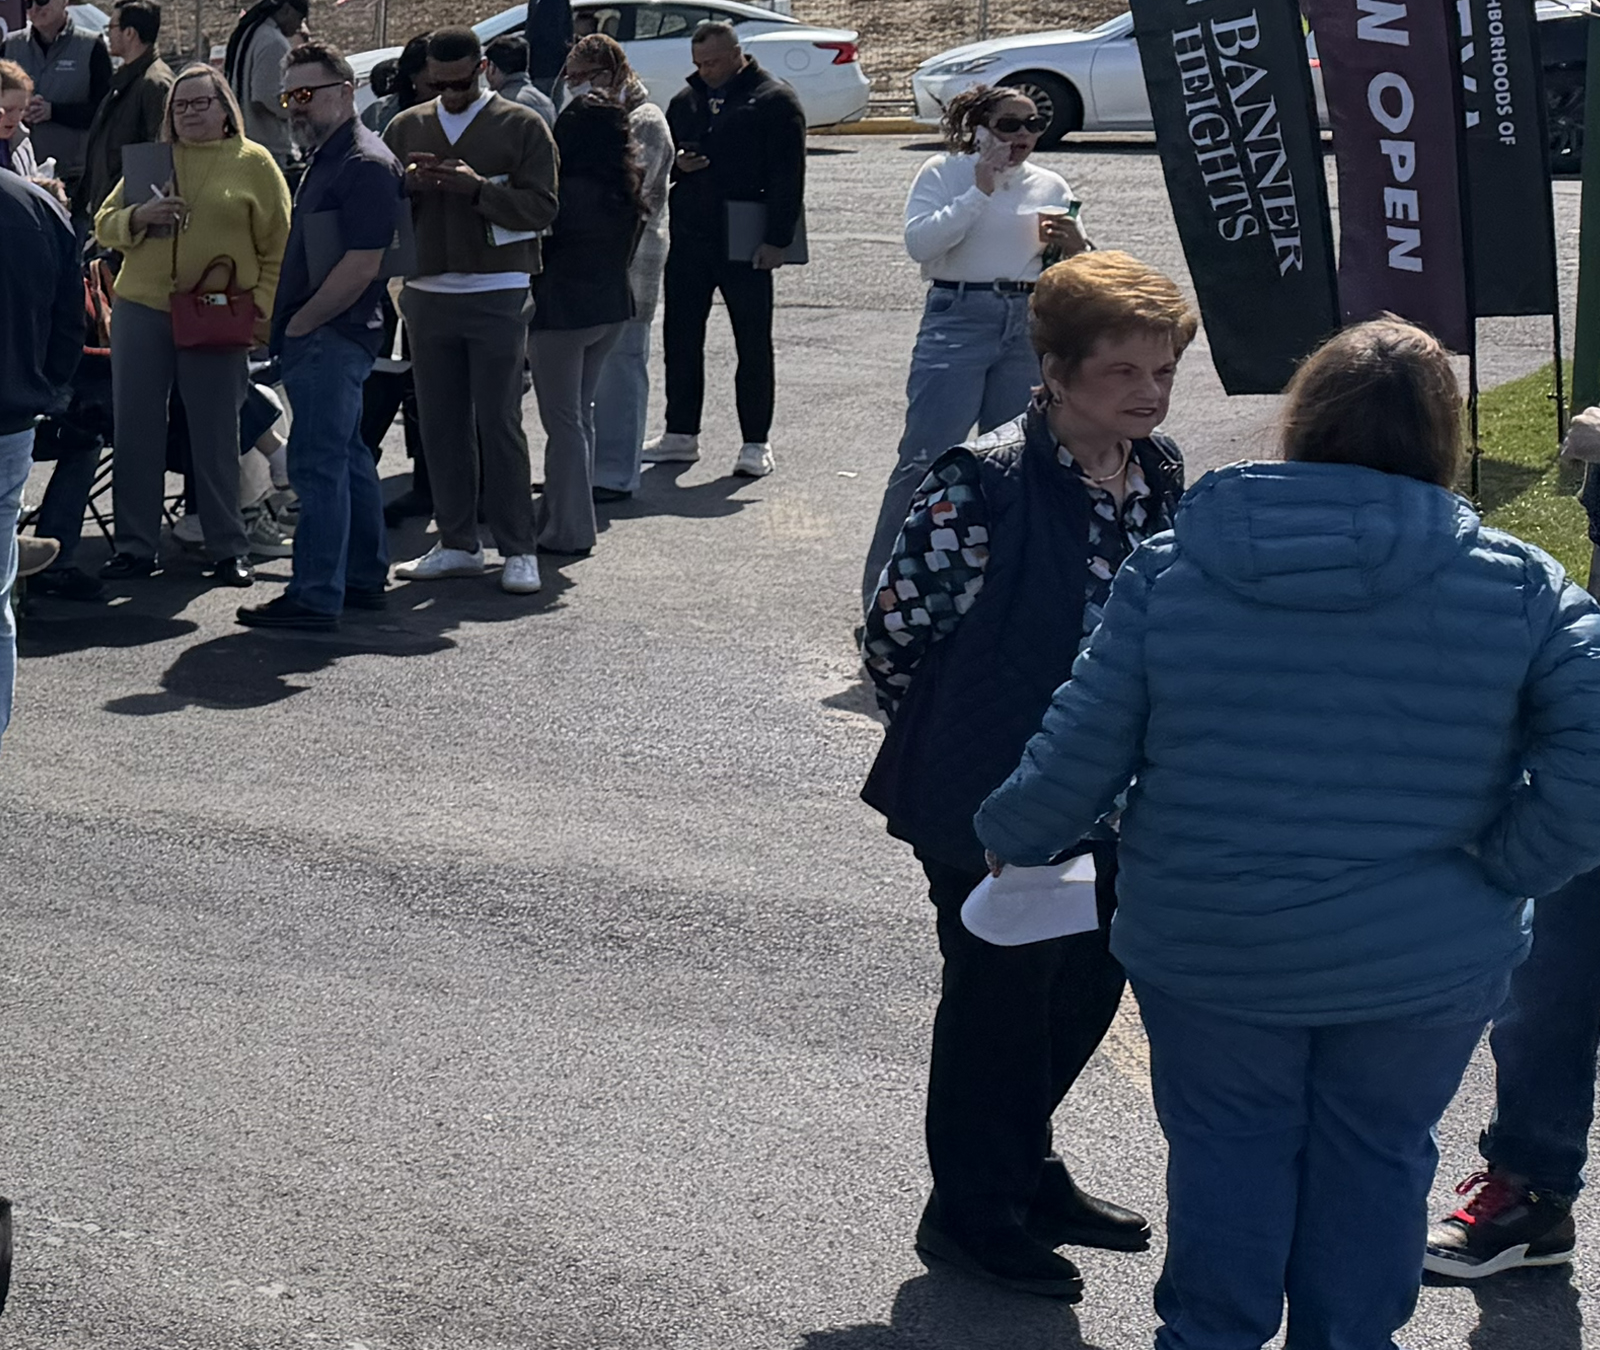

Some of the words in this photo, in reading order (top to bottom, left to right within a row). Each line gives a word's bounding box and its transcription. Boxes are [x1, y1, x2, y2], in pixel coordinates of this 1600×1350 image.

[1171, 22, 1260, 242] HEIGHTS
[1210, 8, 1303, 277] BANNER
[1367, 71, 1423, 273] OPEN
[1499, 119, 1516, 146] OF
